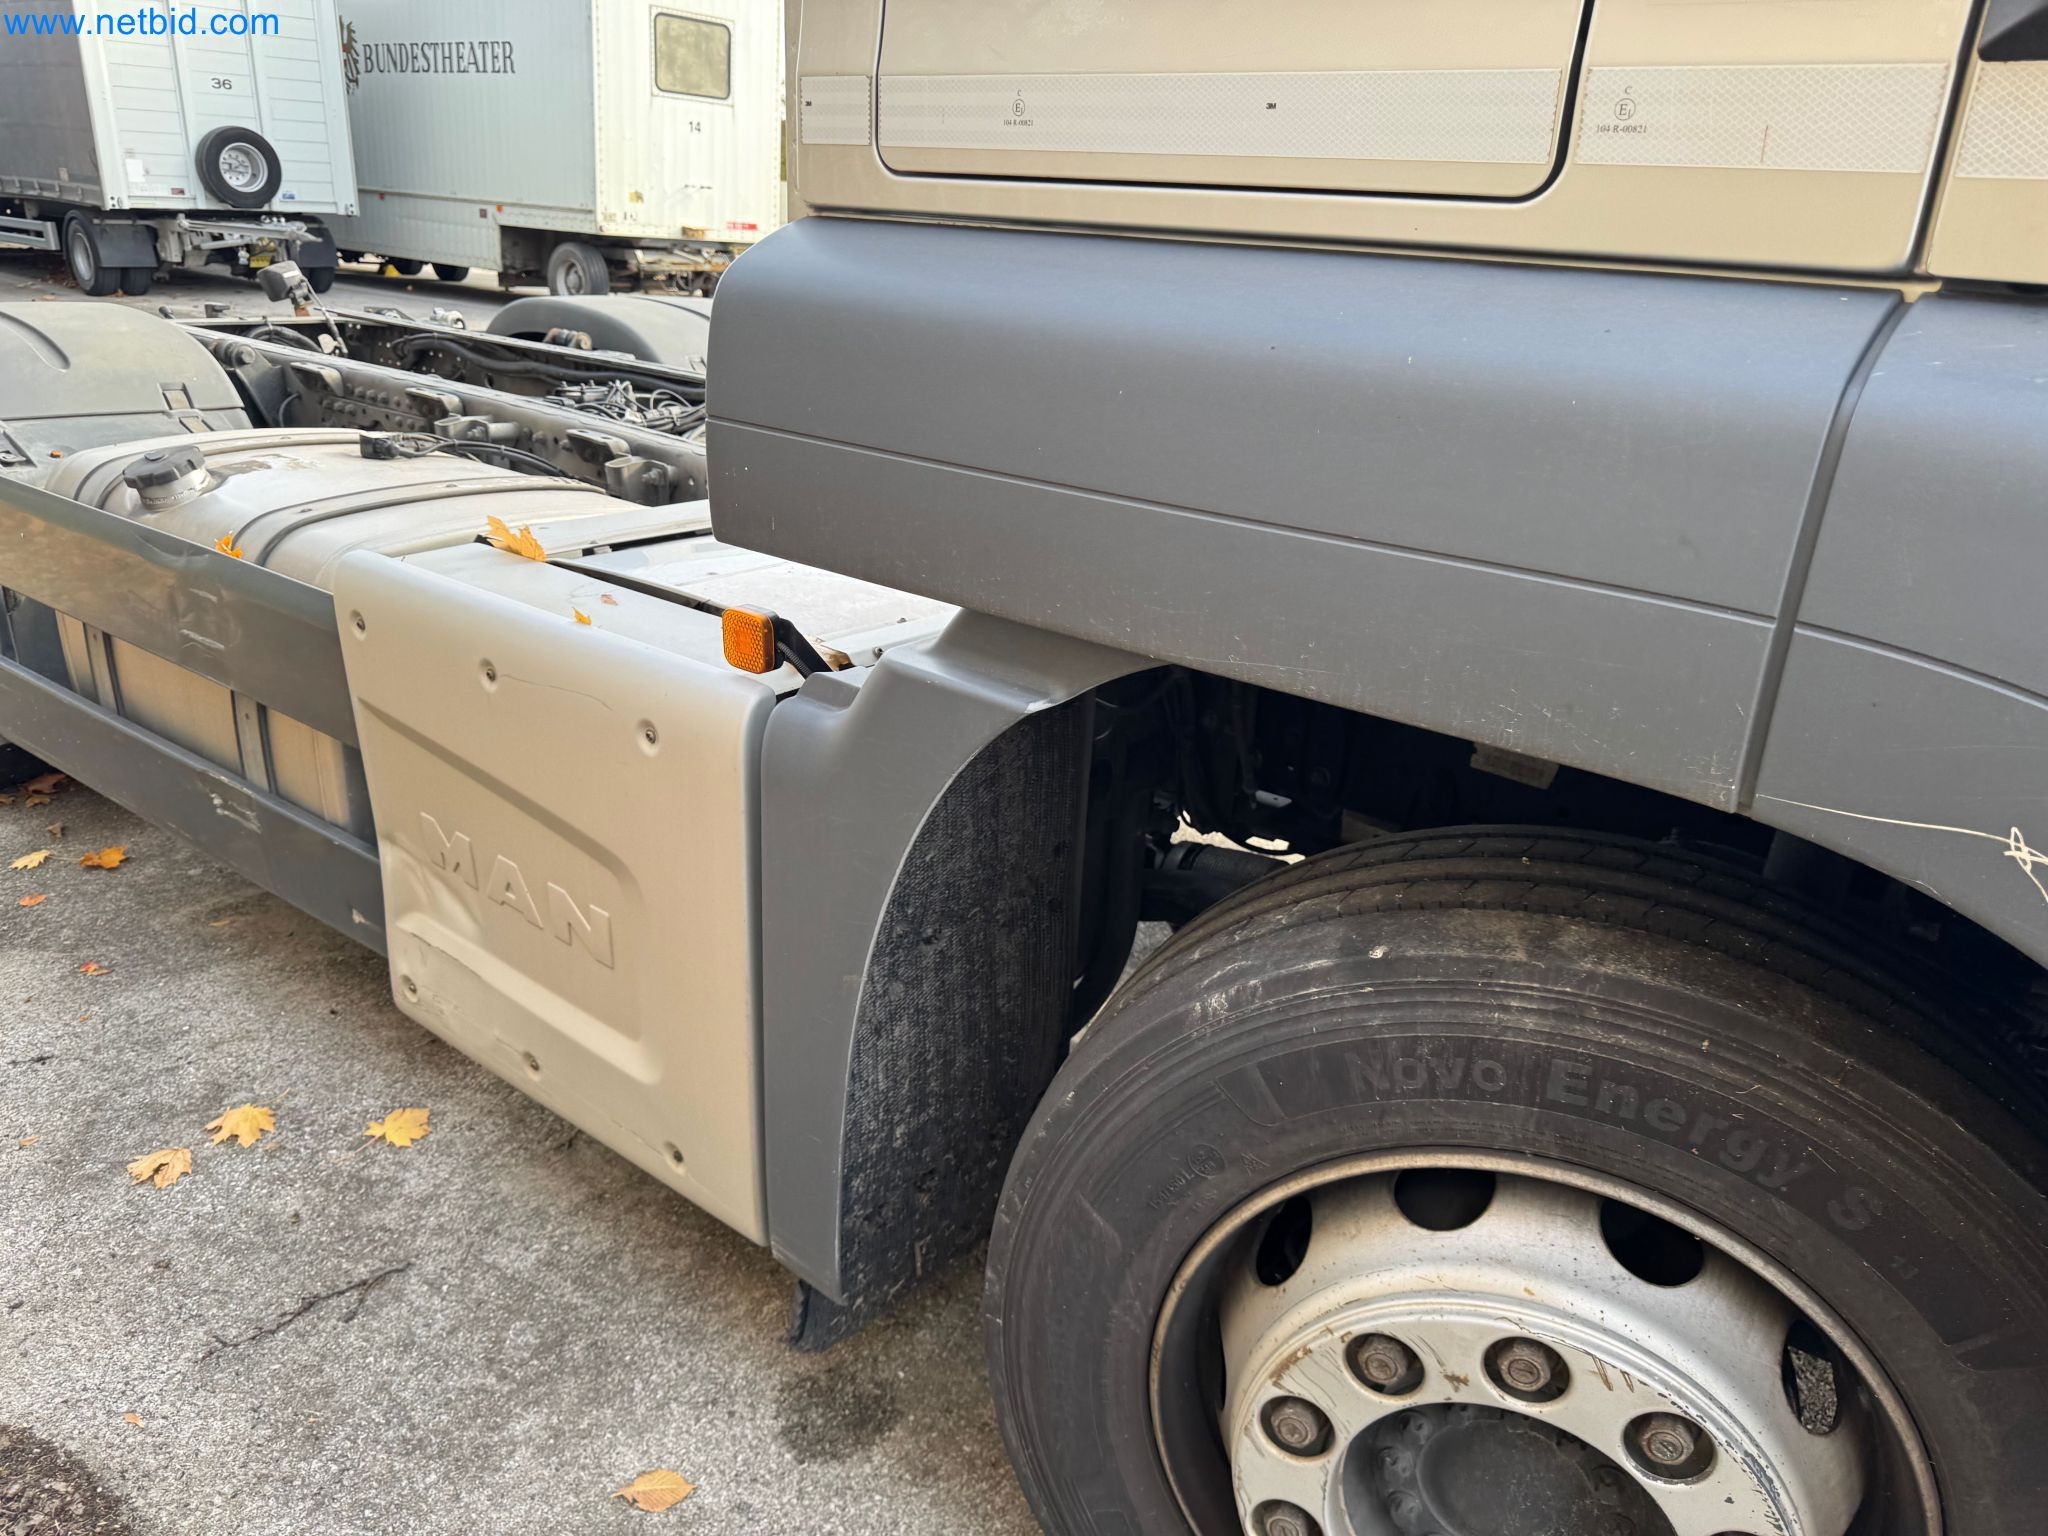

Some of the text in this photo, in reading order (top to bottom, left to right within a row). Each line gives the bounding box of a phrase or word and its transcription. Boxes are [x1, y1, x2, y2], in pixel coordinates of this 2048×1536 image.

[363, 41, 516, 74] BUNDESTHEATER
[211, 77, 232, 90] 36
[1624, 85, 1633, 95] C
[1265, 102, 1277, 110] 3M
[688, 120, 701, 133] 14
[1596, 124, 1611, 133] 104
[419, 811, 614, 970] MAN
[1545, 1058, 1812, 1189] Energy
